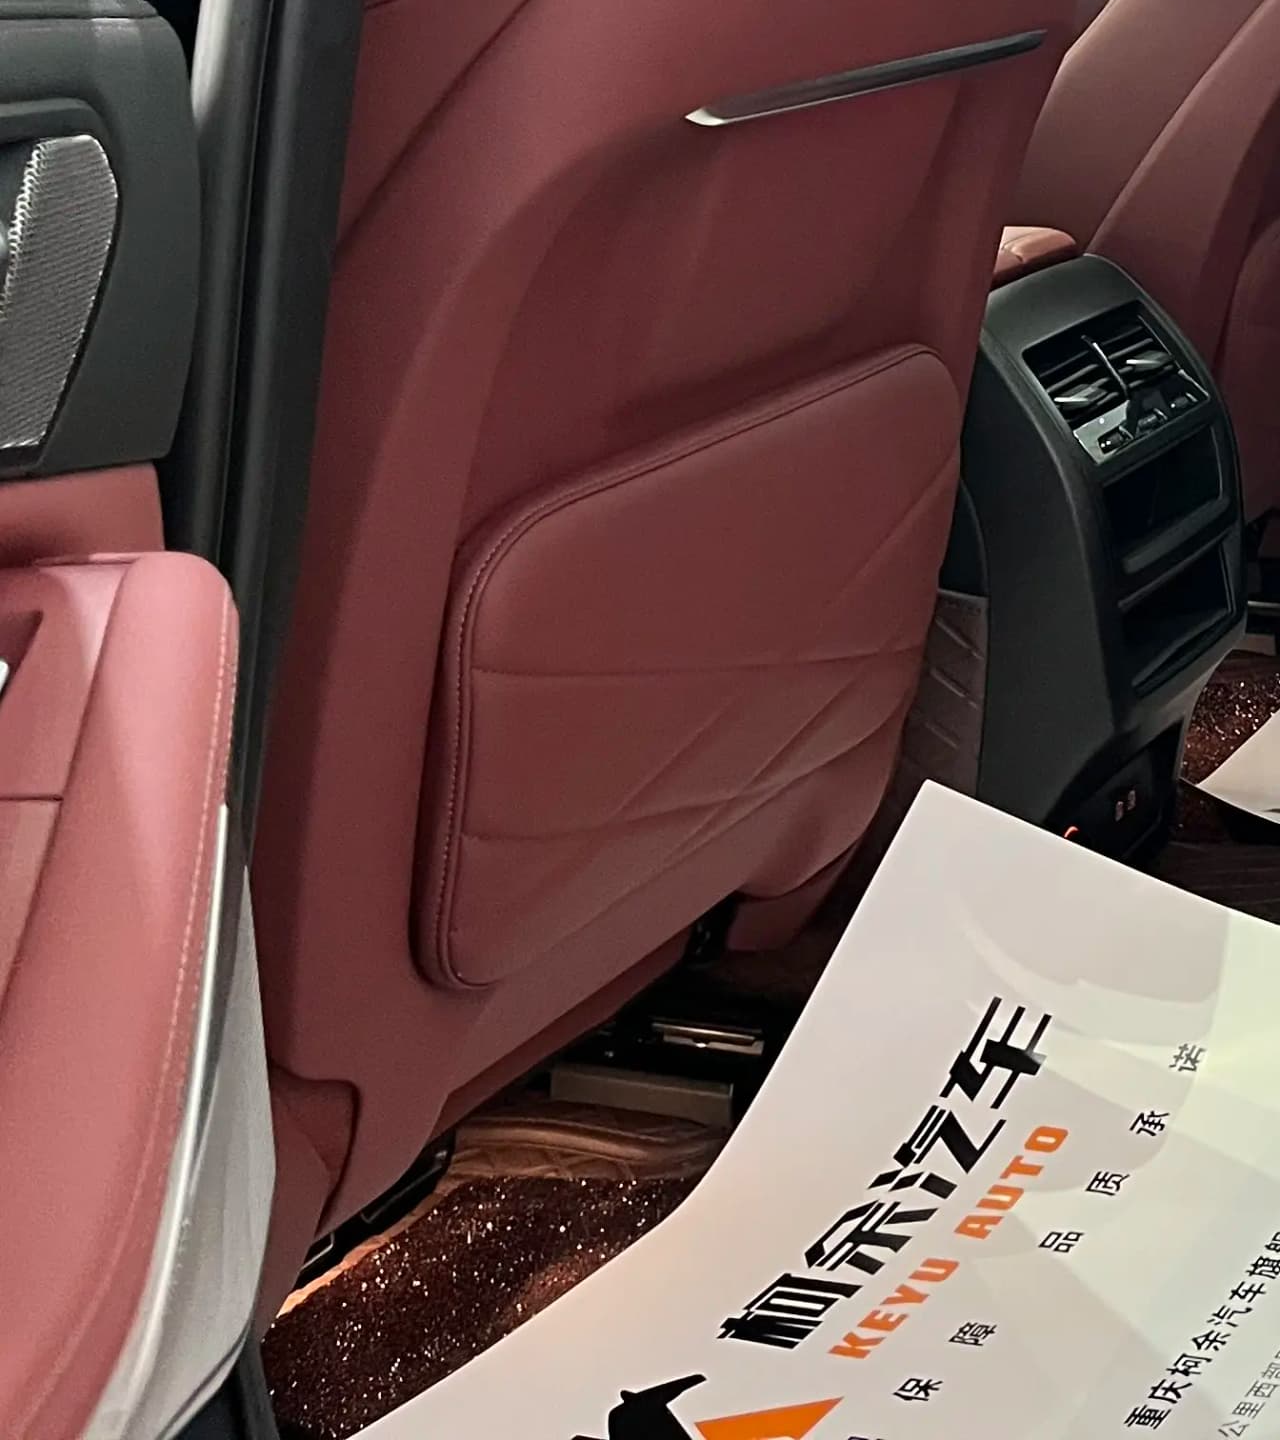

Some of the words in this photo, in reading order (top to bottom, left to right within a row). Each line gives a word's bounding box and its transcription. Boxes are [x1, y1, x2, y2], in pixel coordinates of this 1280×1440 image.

[718, 996, 1052, 1350] 柯余汽车
[829, 1258, 960, 1359] KEYU
[954, 1125, 1069, 1241] AUTO
